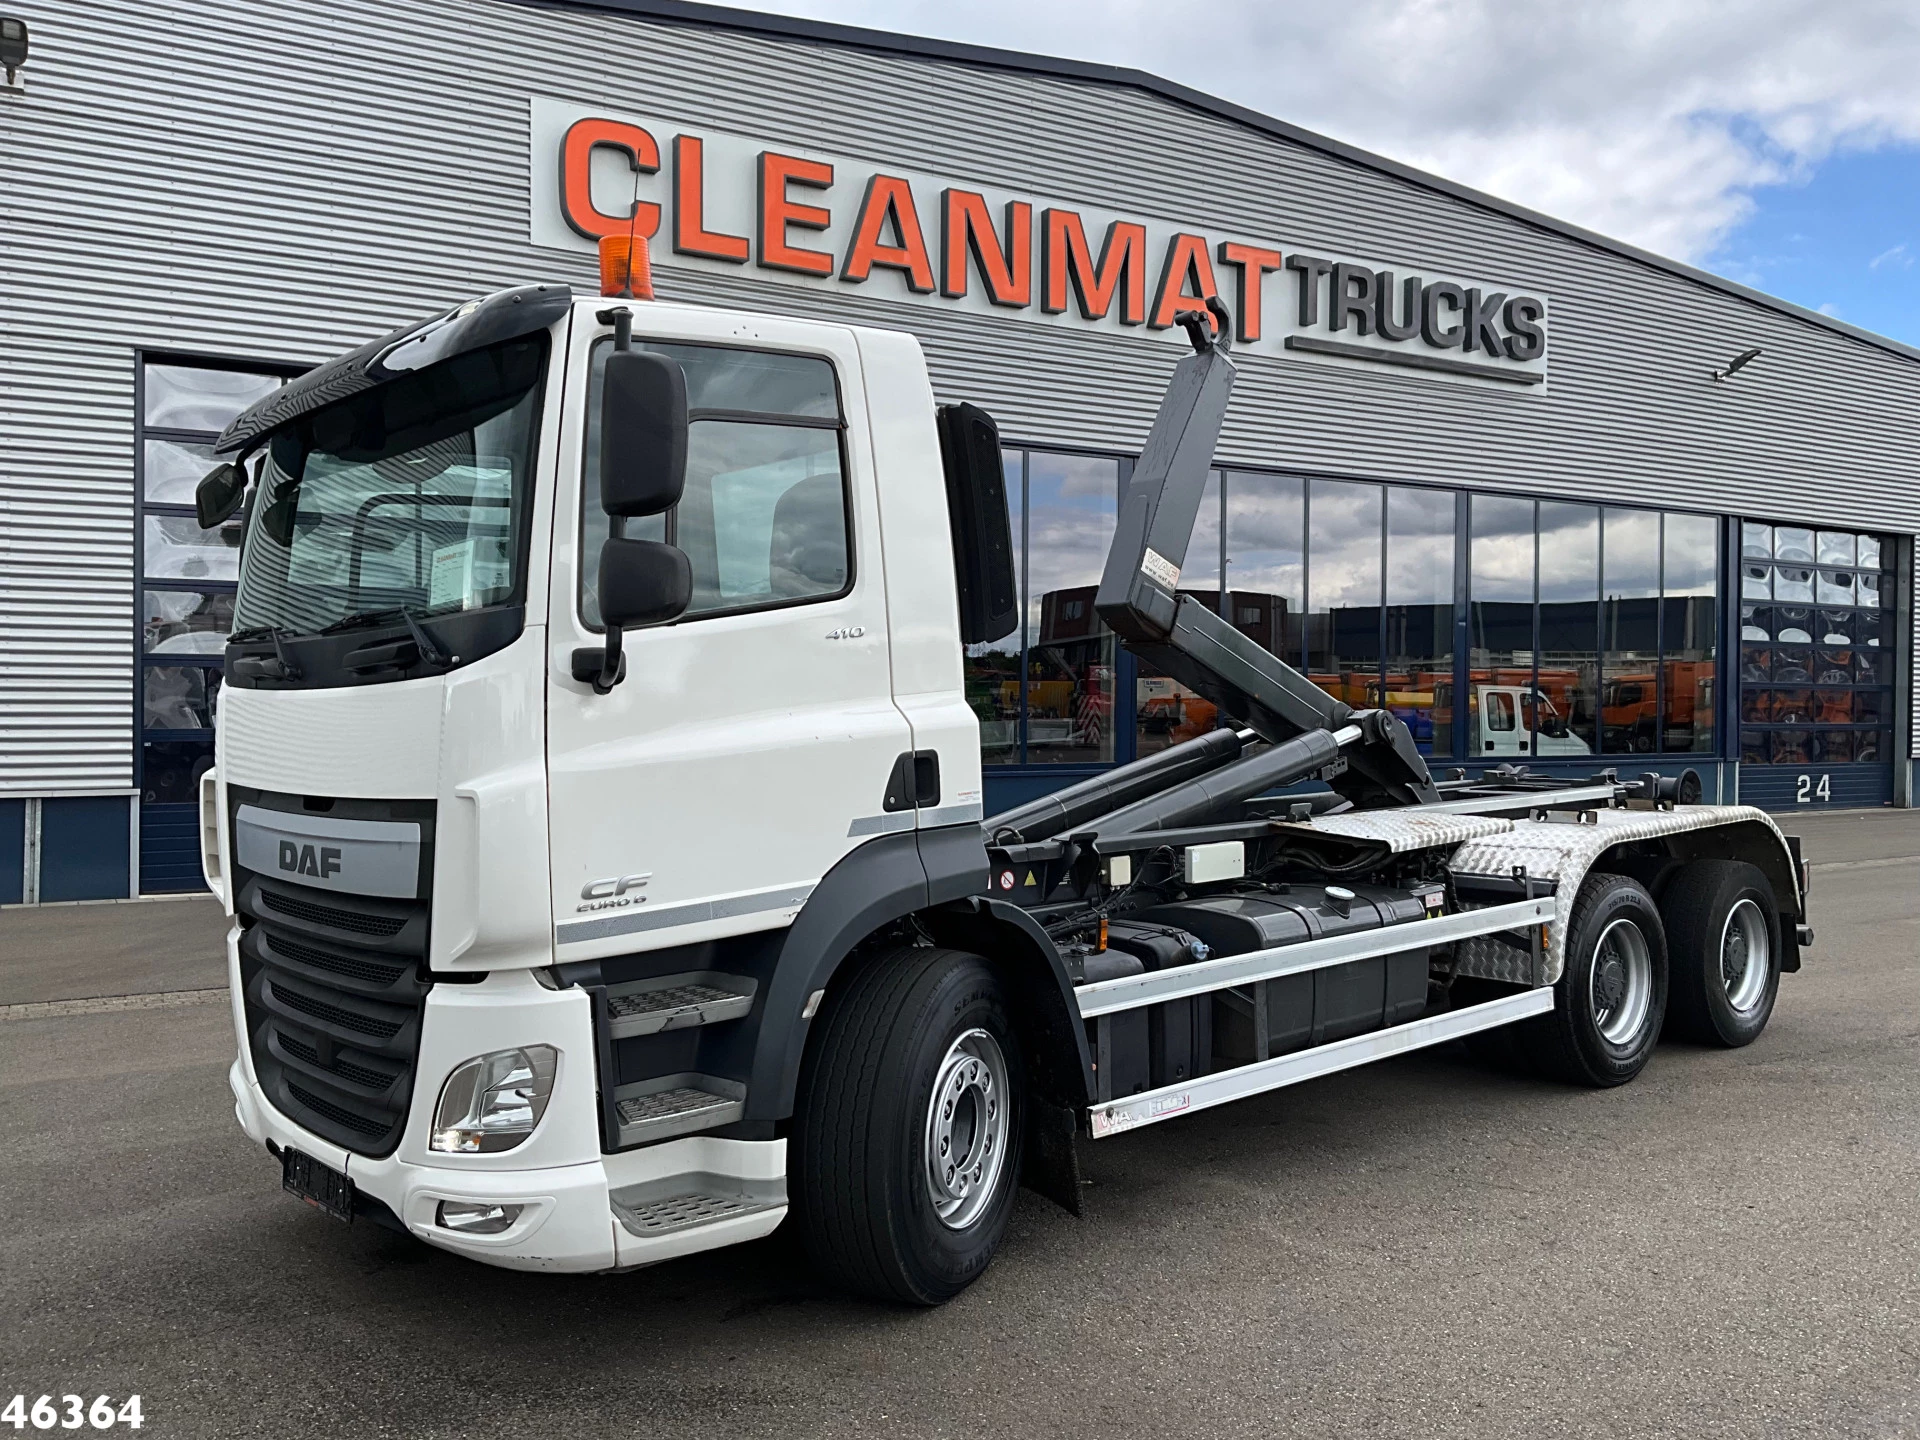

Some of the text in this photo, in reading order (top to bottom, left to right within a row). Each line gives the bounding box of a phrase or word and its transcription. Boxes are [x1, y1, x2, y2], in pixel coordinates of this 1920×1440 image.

[558, 117, 1545, 361] CLEANMAT TRUCKS
[1147, 551, 1178, 578] WAF
[825, 626, 866, 640] 410
[1797, 774, 1831, 803] 24
[278, 840, 342, 879] DAF
[580, 871, 653, 900] CF
[576, 897, 631, 913] EURO
